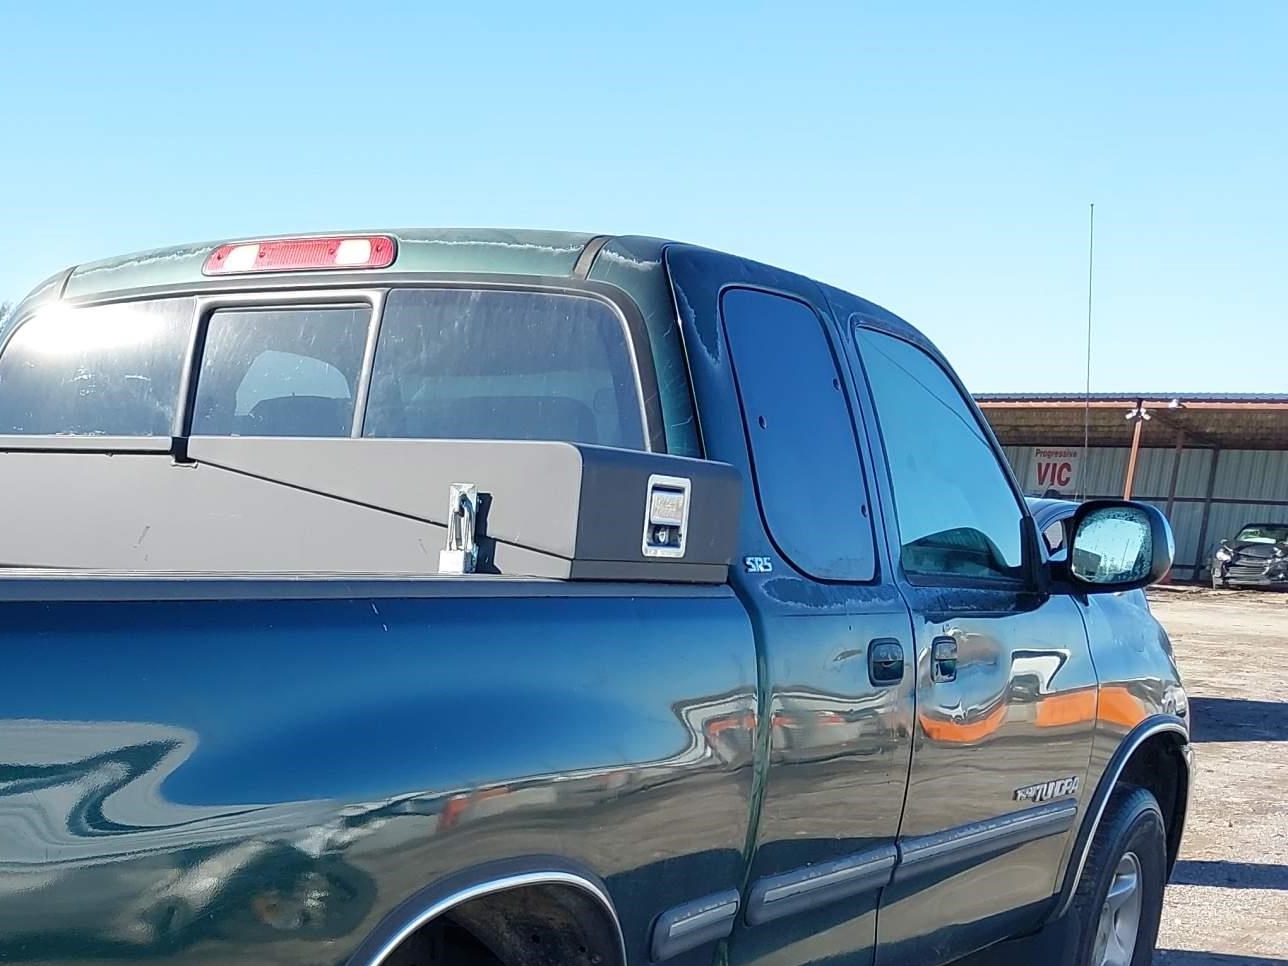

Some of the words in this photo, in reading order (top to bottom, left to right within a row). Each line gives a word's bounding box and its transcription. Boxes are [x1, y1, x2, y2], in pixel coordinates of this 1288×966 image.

[1035, 448, 1078, 459] Progressive
[1037, 462, 1072, 487] VIC
[745, 556, 773, 573] SR5
